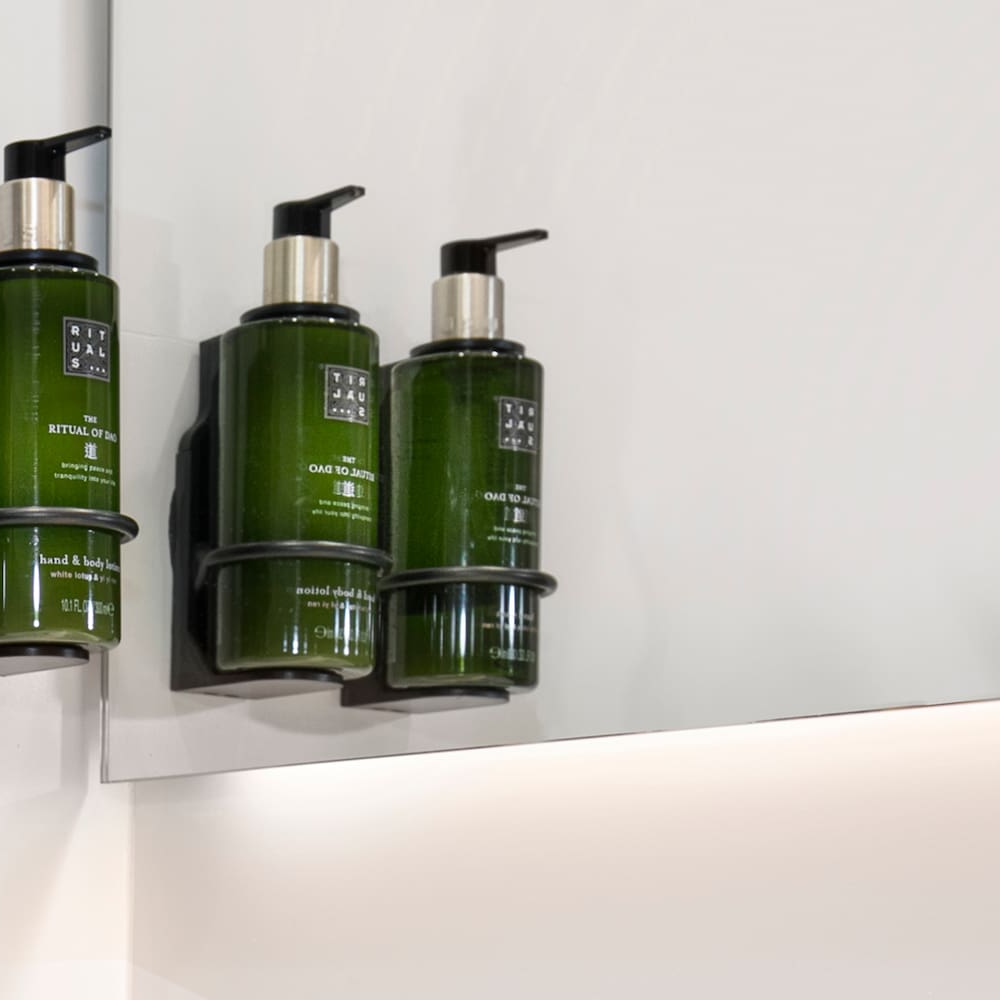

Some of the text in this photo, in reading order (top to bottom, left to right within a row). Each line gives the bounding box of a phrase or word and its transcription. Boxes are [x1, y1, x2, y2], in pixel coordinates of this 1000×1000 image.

[83, 414, 97, 424] THE
[48, 423, 89, 437] RITUAL
[91, 427, 103, 439] OF
[61, 462, 88, 472] bringing
[40, 554, 69, 565] hand
[72, 555, 81, 566] &
[83, 555, 104, 571] body
[50, 570, 72, 579] white
